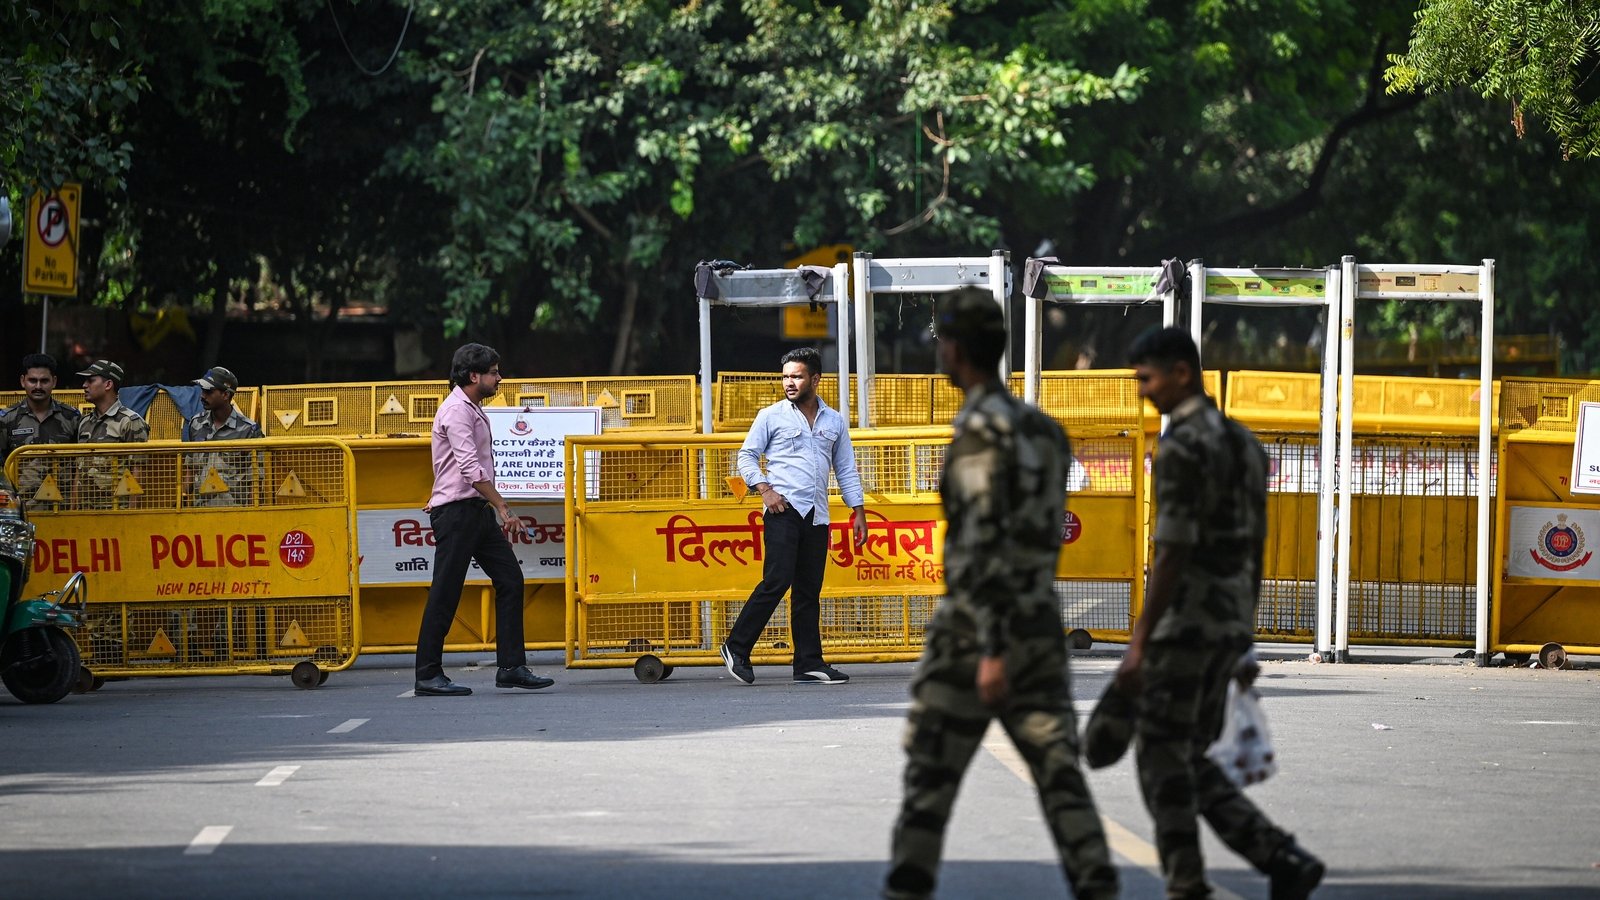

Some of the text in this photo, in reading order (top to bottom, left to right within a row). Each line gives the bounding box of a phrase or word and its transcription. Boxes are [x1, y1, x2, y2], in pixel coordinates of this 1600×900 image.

[44, 256, 57, 269] No
[33, 267, 68, 285] Parking
[492, 439, 526, 447] CCTV
[501, 460, 523, 468] ARE
[526, 460, 563, 468] UNDER
[538, 470, 553, 478] OF
[34, 533, 270, 574] DELHI POLICE
[855, 559, 891, 581] जिला
[895, 560, 917, 581] नई
[589, 574, 600, 584] 70
[156, 583, 183, 596] NEW
[188, 582, 226, 595] DELHI
